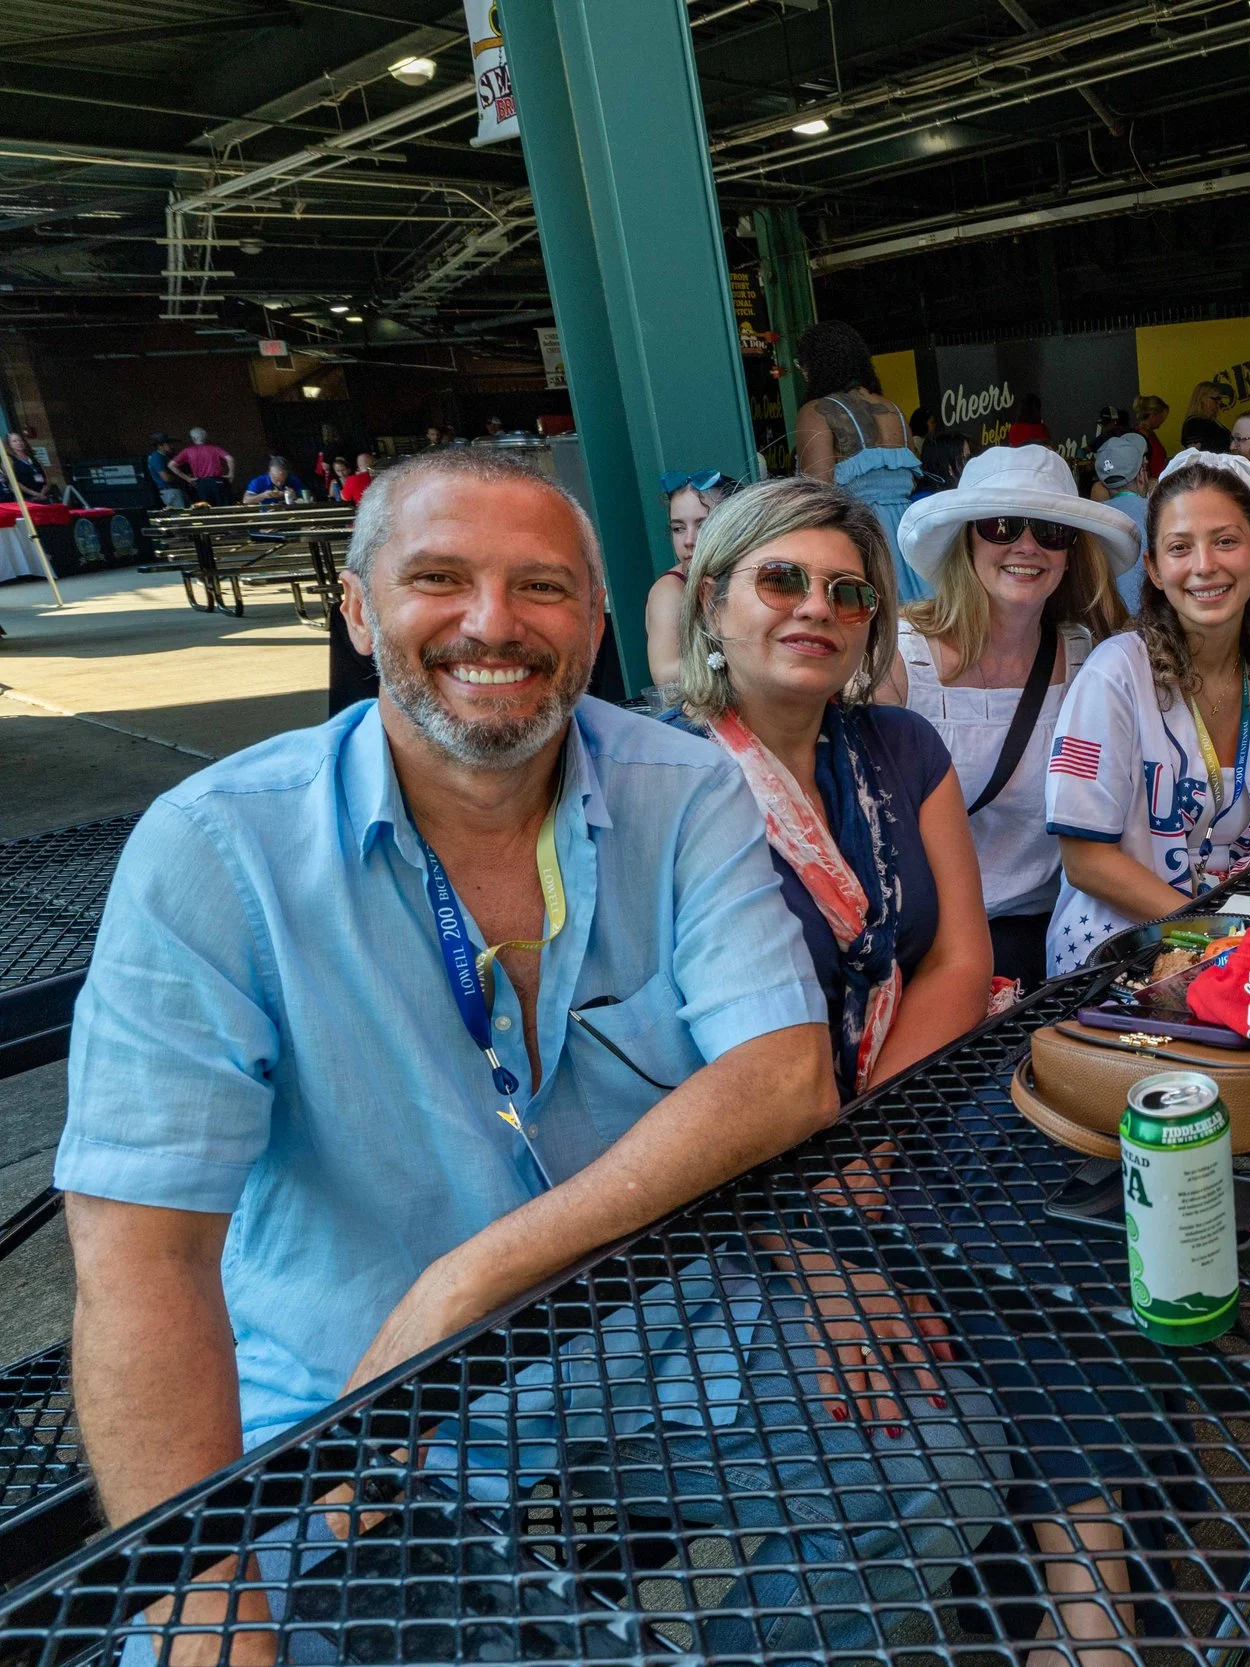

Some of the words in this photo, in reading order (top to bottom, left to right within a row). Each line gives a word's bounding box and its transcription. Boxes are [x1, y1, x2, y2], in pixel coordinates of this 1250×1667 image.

[941, 381, 1014, 427] Cheers
[1235, 766, 1244, 786] 200
[543, 868, 560, 914] LOWELL
[437, 907, 461, 941] 200
[452, 945, 476, 997] LOWELL
[1161, 1111, 1224, 1138] FIDDLEHEAD
